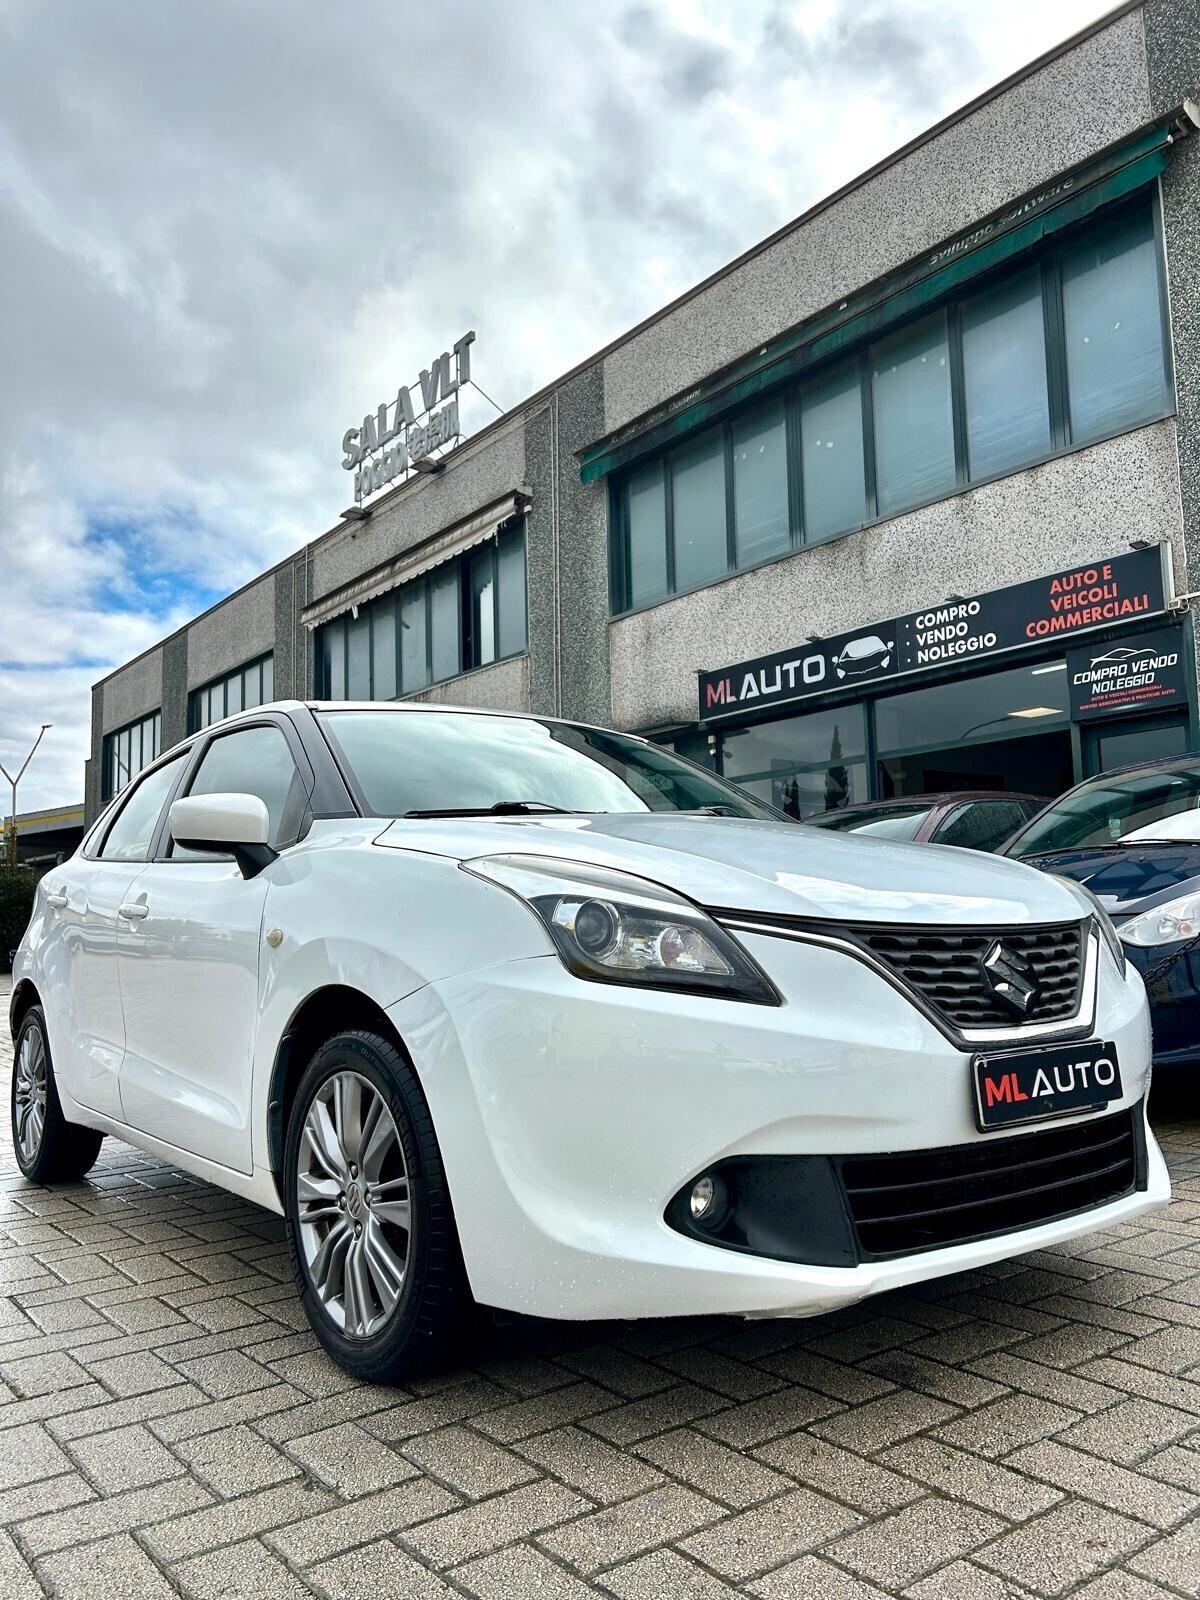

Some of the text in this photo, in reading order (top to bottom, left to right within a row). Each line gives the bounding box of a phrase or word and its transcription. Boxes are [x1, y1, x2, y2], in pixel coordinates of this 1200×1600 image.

[342, 330, 476, 470] SALA VLT
[1050, 563, 1113, 595] AUTO E
[1050, 583, 1118, 612] VEICOLI
[915, 601, 981, 630] COMPRO
[1025, 594, 1149, 638] COMMERCIALI
[916, 622, 969, 647] VENDO
[917, 632, 997, 664] NOLEGGIO
[1073, 653, 1178, 685] COMPRO VENDO
[1091, 672, 1155, 694] NOLEGGIO
[1128, 685, 1162, 695] COMMERCIALI
[1136, 691, 1161, 700] PRATICHE
[1161, 688, 1176, 696] AUTO
[984, 1058, 1115, 1107] ML AUTO
